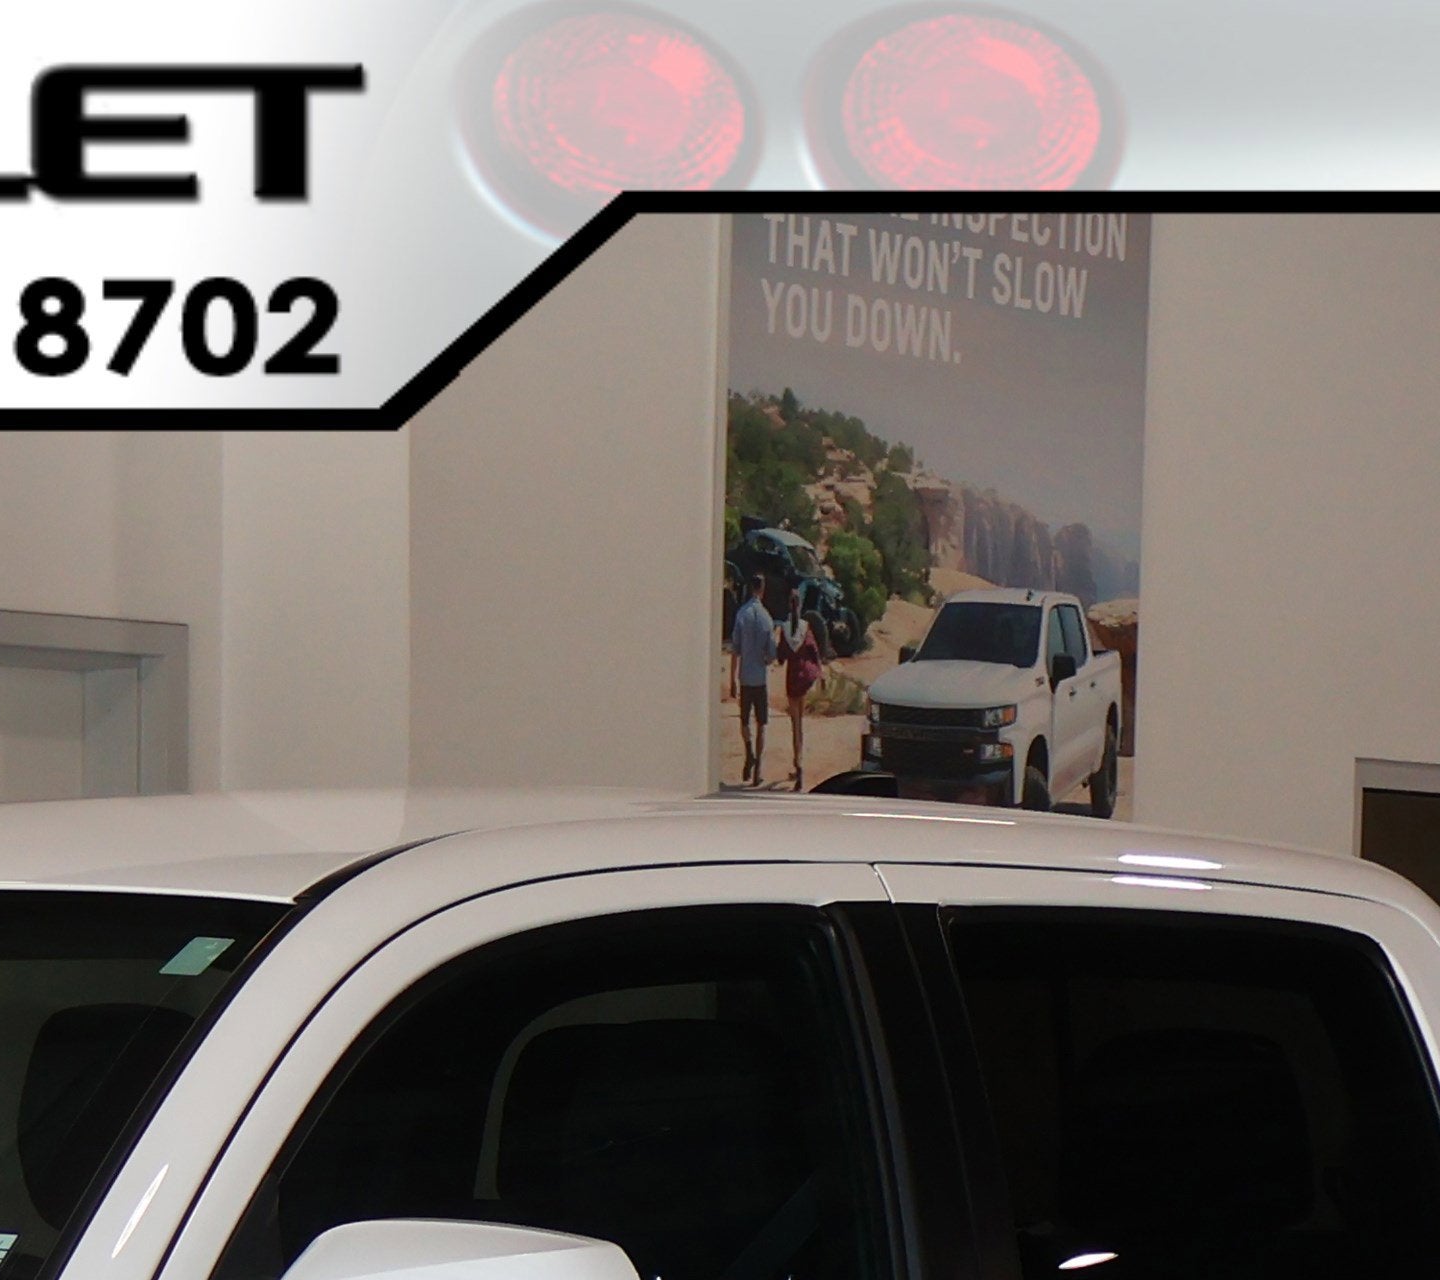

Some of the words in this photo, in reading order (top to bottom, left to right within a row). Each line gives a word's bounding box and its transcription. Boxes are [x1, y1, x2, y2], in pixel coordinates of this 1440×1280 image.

[762, 213, 858, 277] THAT
[868, 228, 983, 300] WON'T
[991, 252, 1089, 319] SLOW
[760, 278, 833, 343] YOU
[845, 293, 962, 365] DOWN.
